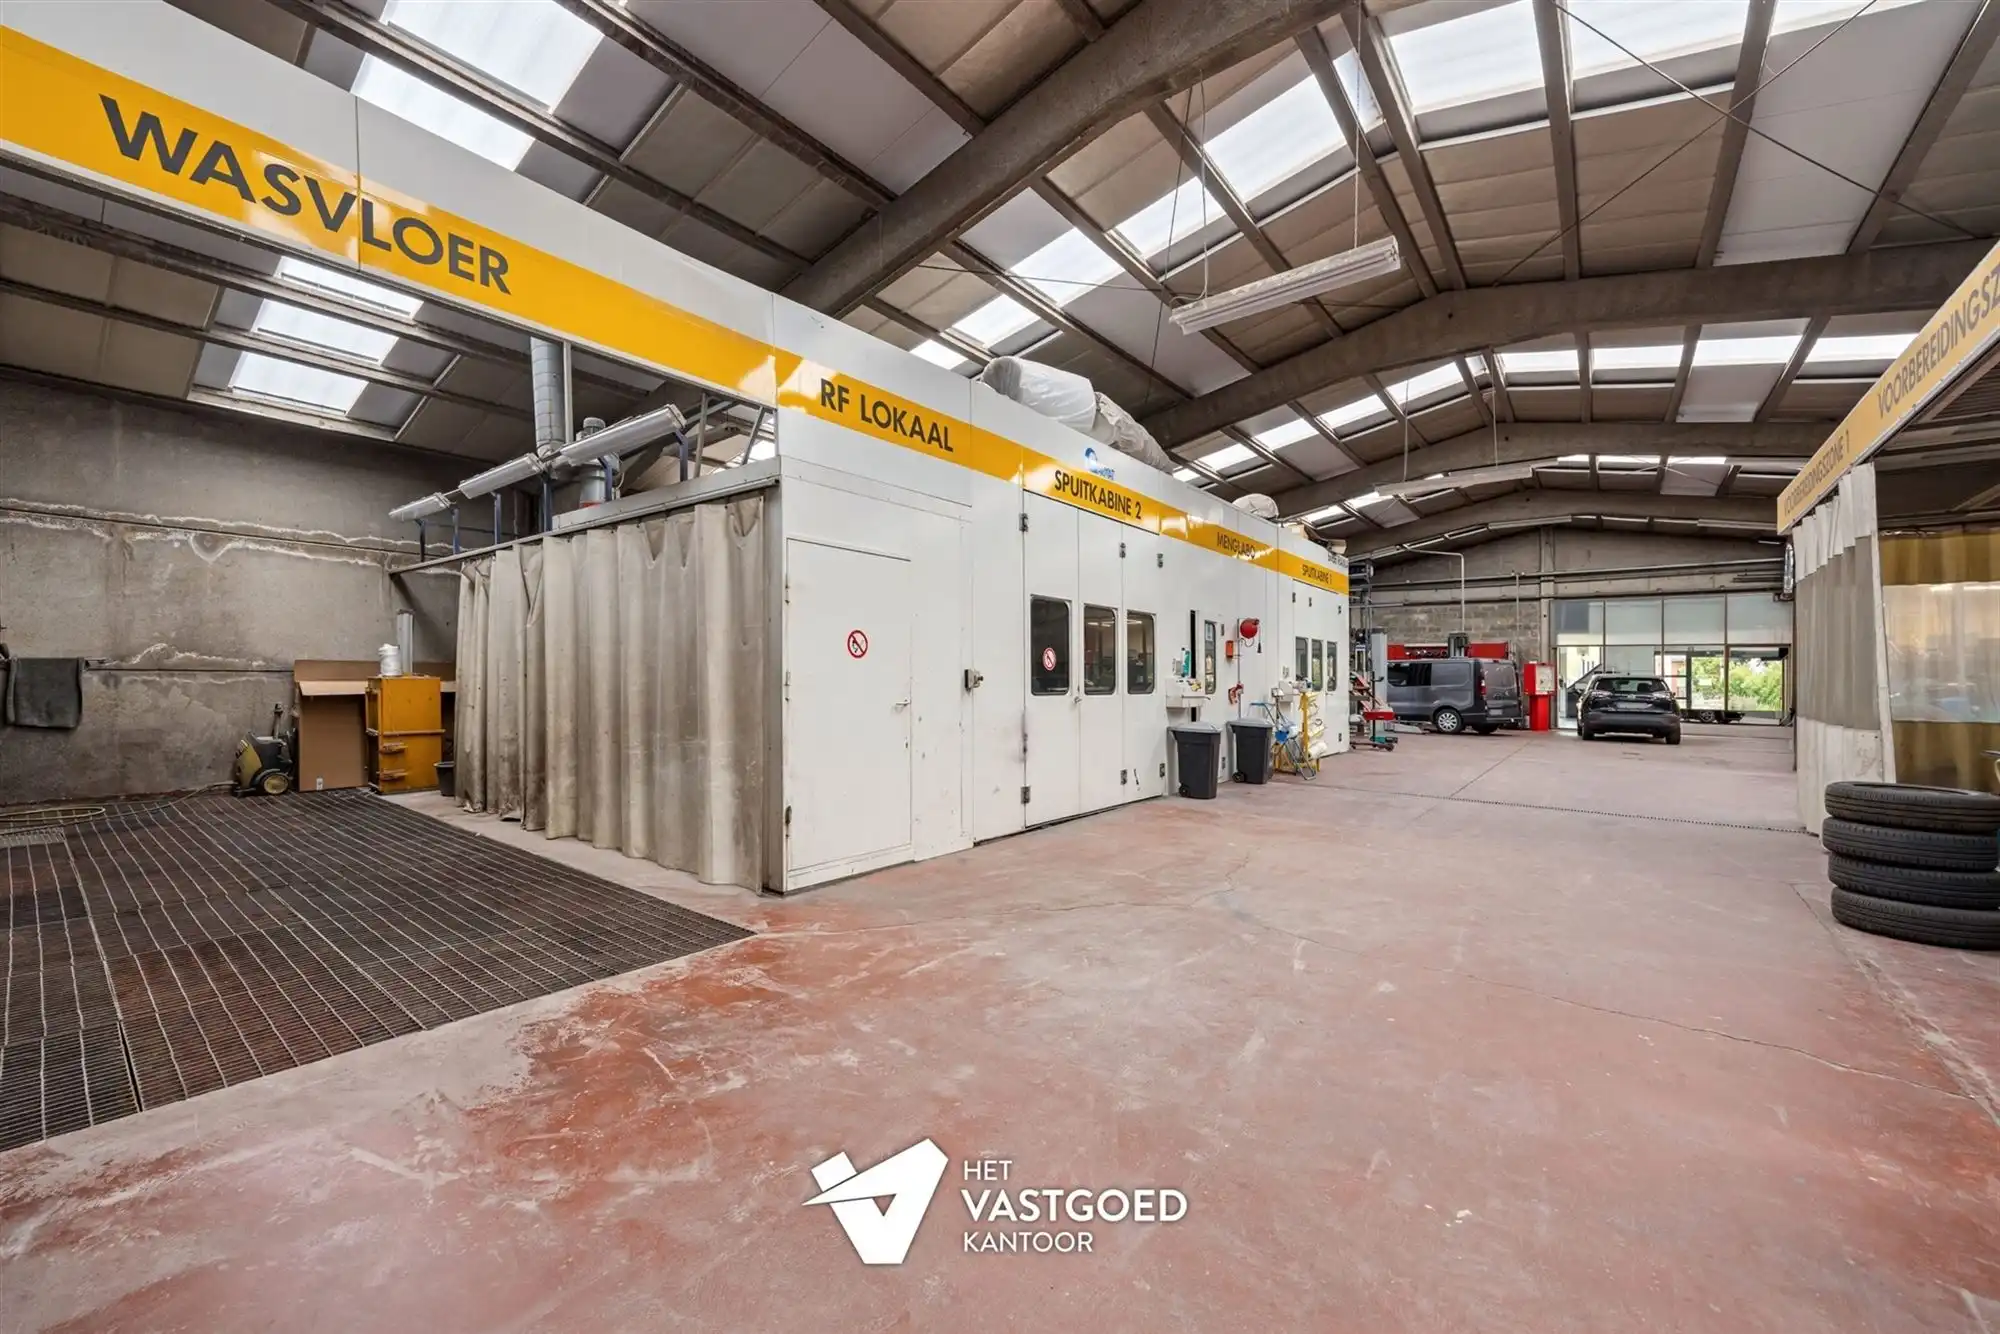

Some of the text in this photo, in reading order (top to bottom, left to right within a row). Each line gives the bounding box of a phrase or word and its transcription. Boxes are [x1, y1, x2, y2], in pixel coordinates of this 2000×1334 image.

[99, 94, 511, 296] WASVLOER
[820, 378, 954, 453] RF LOKAAL
[1054, 469, 1132, 517] SPUITKABINE
[1135, 500, 1142, 520] 2
[1217, 531, 1256, 560] MENGLABO
